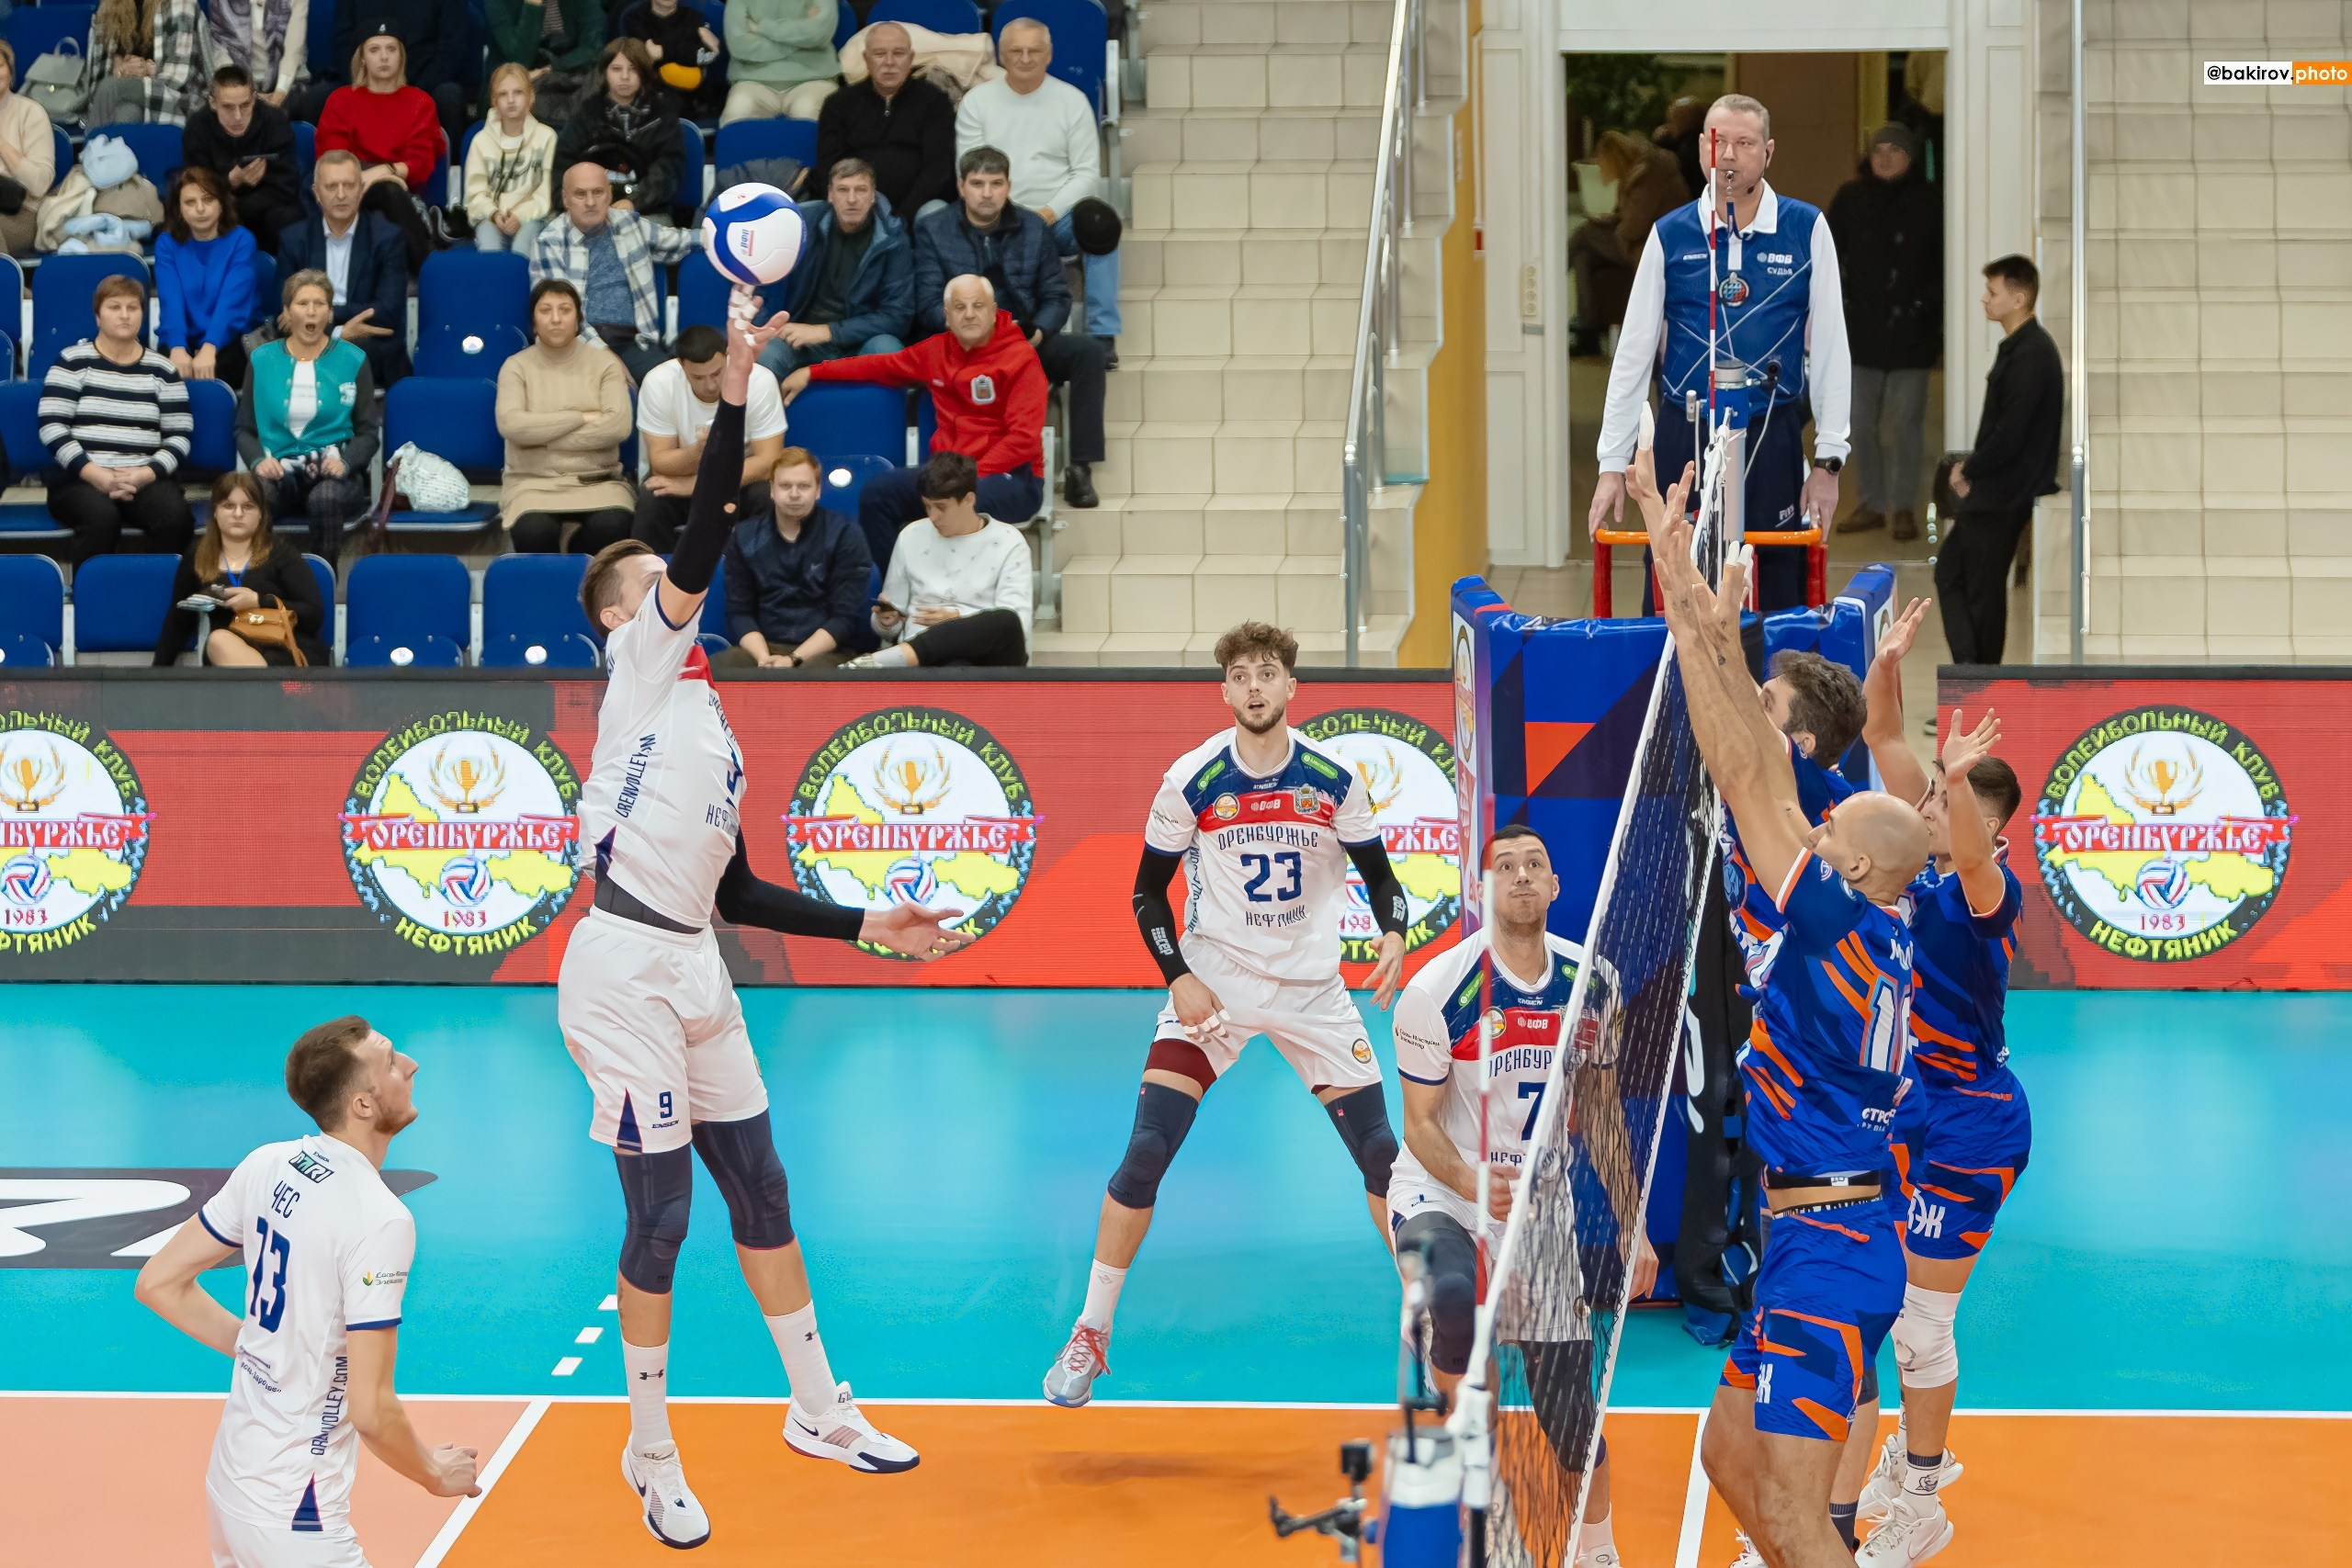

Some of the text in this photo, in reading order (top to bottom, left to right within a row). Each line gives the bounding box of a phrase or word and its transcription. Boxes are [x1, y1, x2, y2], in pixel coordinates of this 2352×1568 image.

[2045, 710, 2279, 801] ВОЛЕЙБОЛЬНЫЙ КЛУБ
[370, 821, 561, 851] ОРЕНБУРЖЬЕ
[814, 823, 1009, 852] ОРЕНБУРЖЬЕ
[1218, 825, 1319, 852] ОРЕНБУРЖЬЕ
[2064, 824, 2262, 852] ОРЕНБУРЖЬЕ
[1239, 851, 1303, 903] 23
[394, 915, 538, 957] НЕФТЯНИК
[2090, 919, 2238, 962] НЕФТЯНИК
[2140, 913, 2187, 931] 1983
[659, 1090, 673, 1119] 9
[1518, 1081, 1548, 1142] 7
[271, 1179, 301, 1219] ЧЕС
[250, 1215, 291, 1334] 13
